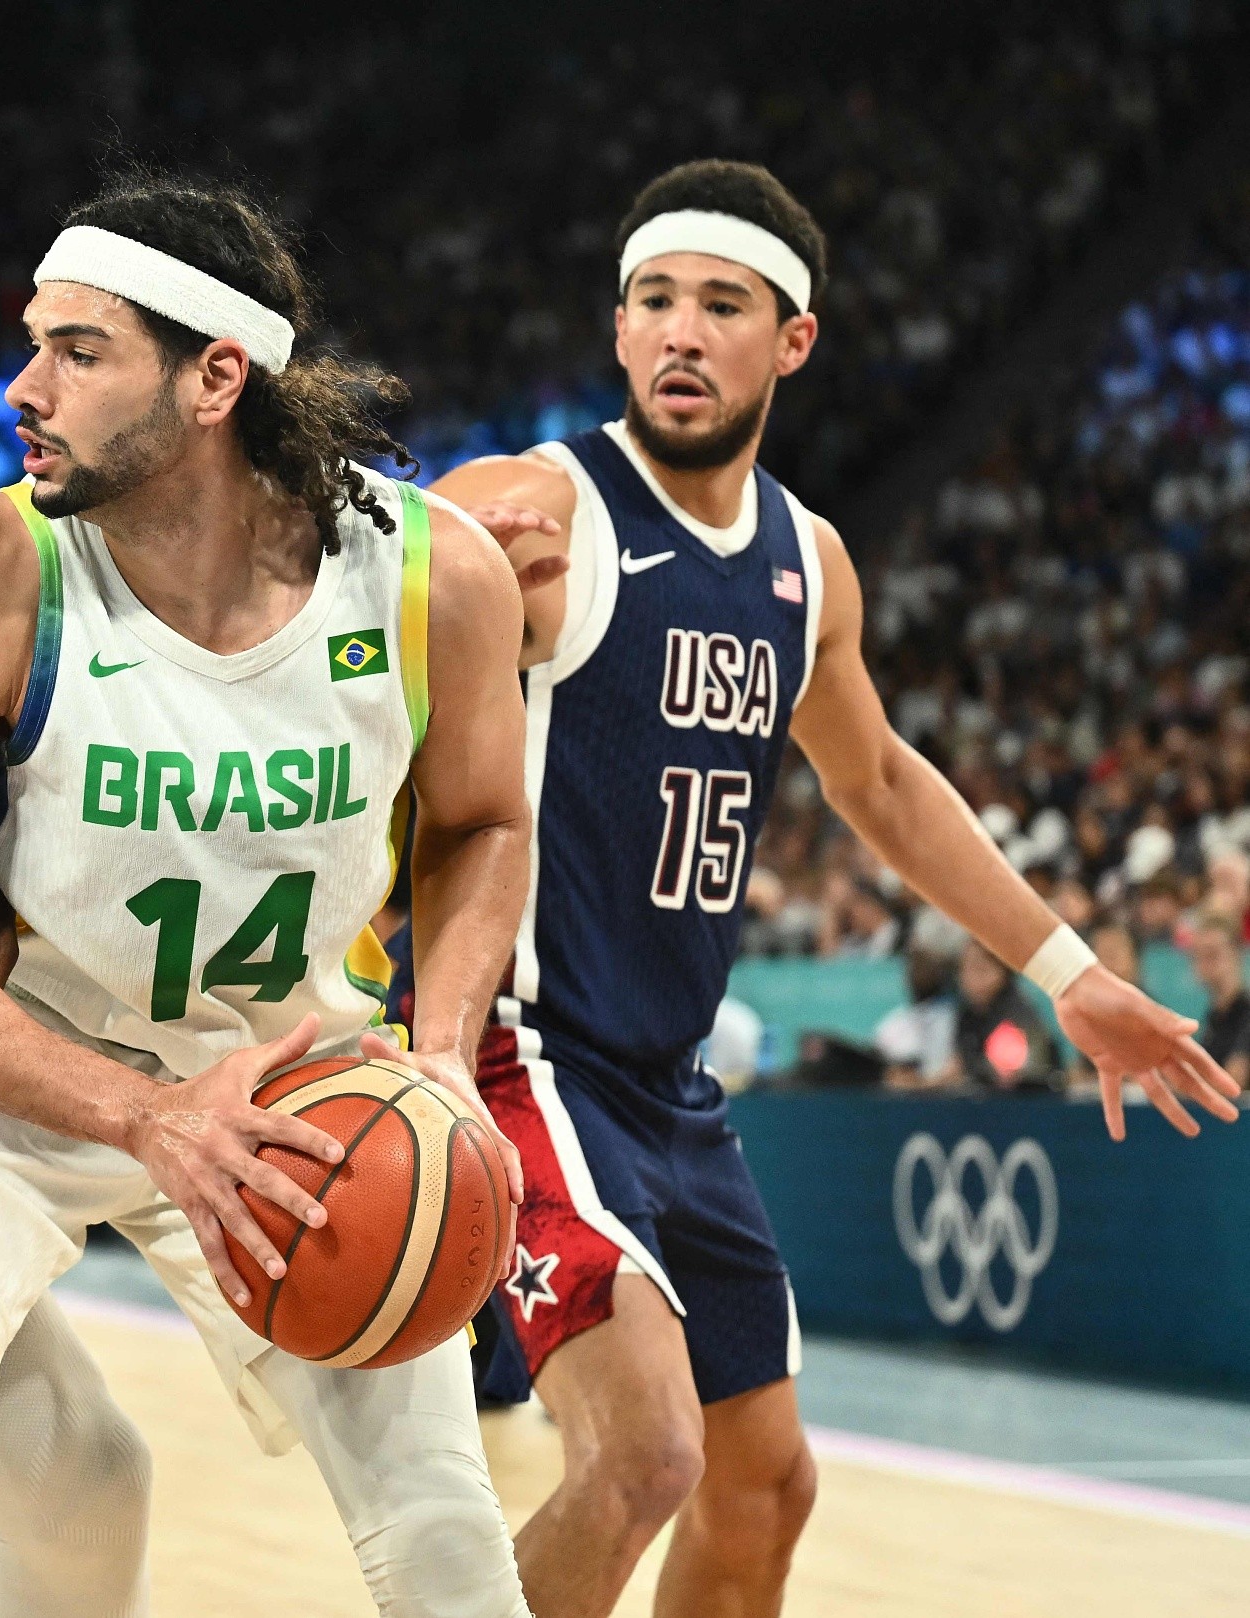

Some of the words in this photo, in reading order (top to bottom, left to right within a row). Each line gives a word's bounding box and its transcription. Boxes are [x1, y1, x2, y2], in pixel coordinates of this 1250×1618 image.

[660, 628, 778, 738] USA
[82, 742, 368, 832] BRASIL
[650, 766, 751, 913] 15
[125, 871, 316, 1022] 14
[461, 1200, 485, 1289] 2024
